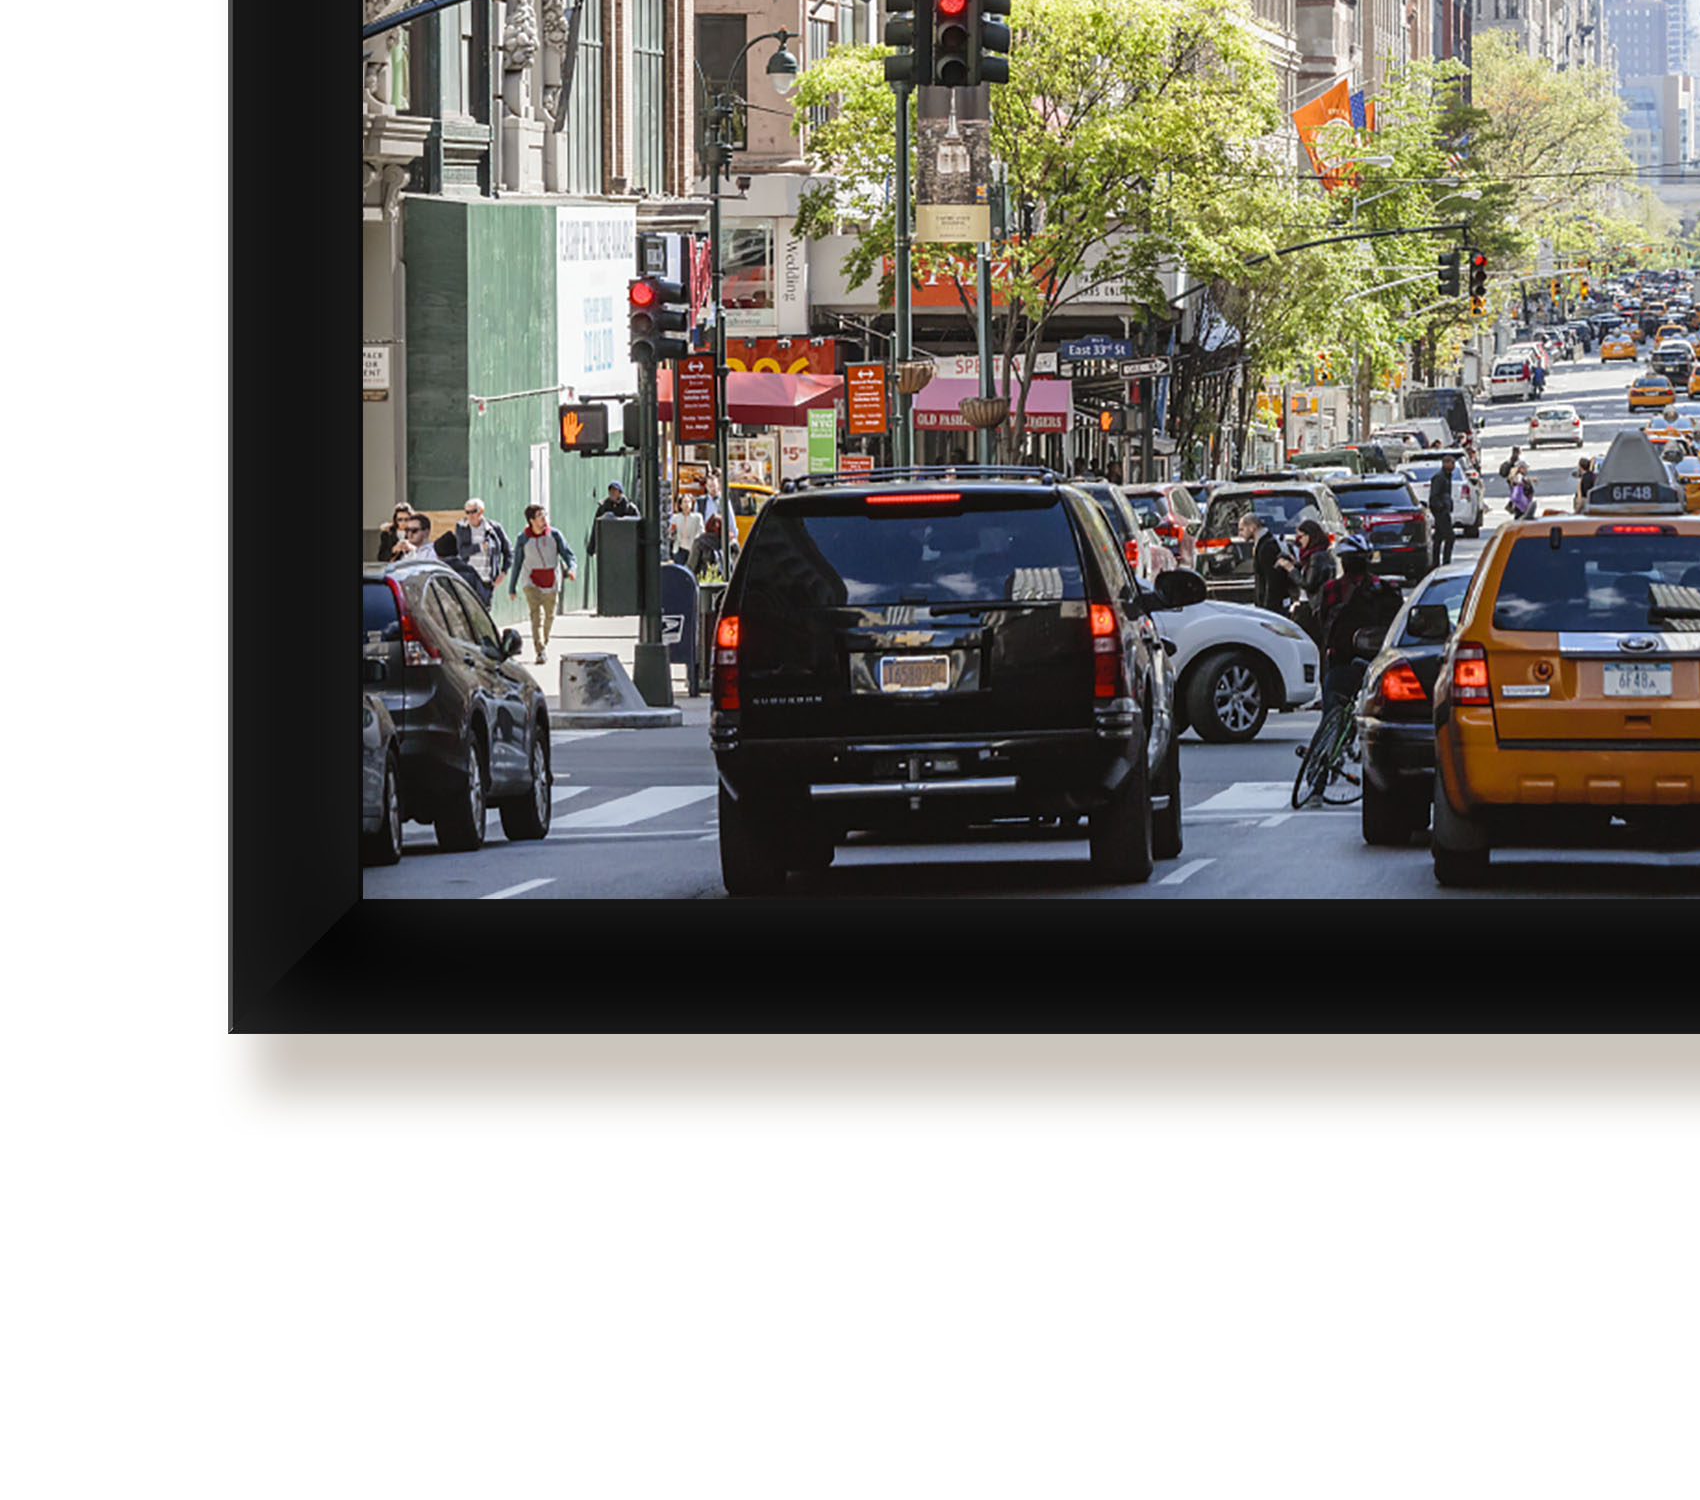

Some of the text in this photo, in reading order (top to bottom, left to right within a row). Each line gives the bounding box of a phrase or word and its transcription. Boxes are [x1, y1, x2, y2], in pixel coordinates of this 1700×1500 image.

[785, 240, 800, 302] Wedding
[1068, 342, 1126, 356] East 33rd St
[917, 413, 937, 426] OLD
[1612, 485, 1652, 500] 6F48
